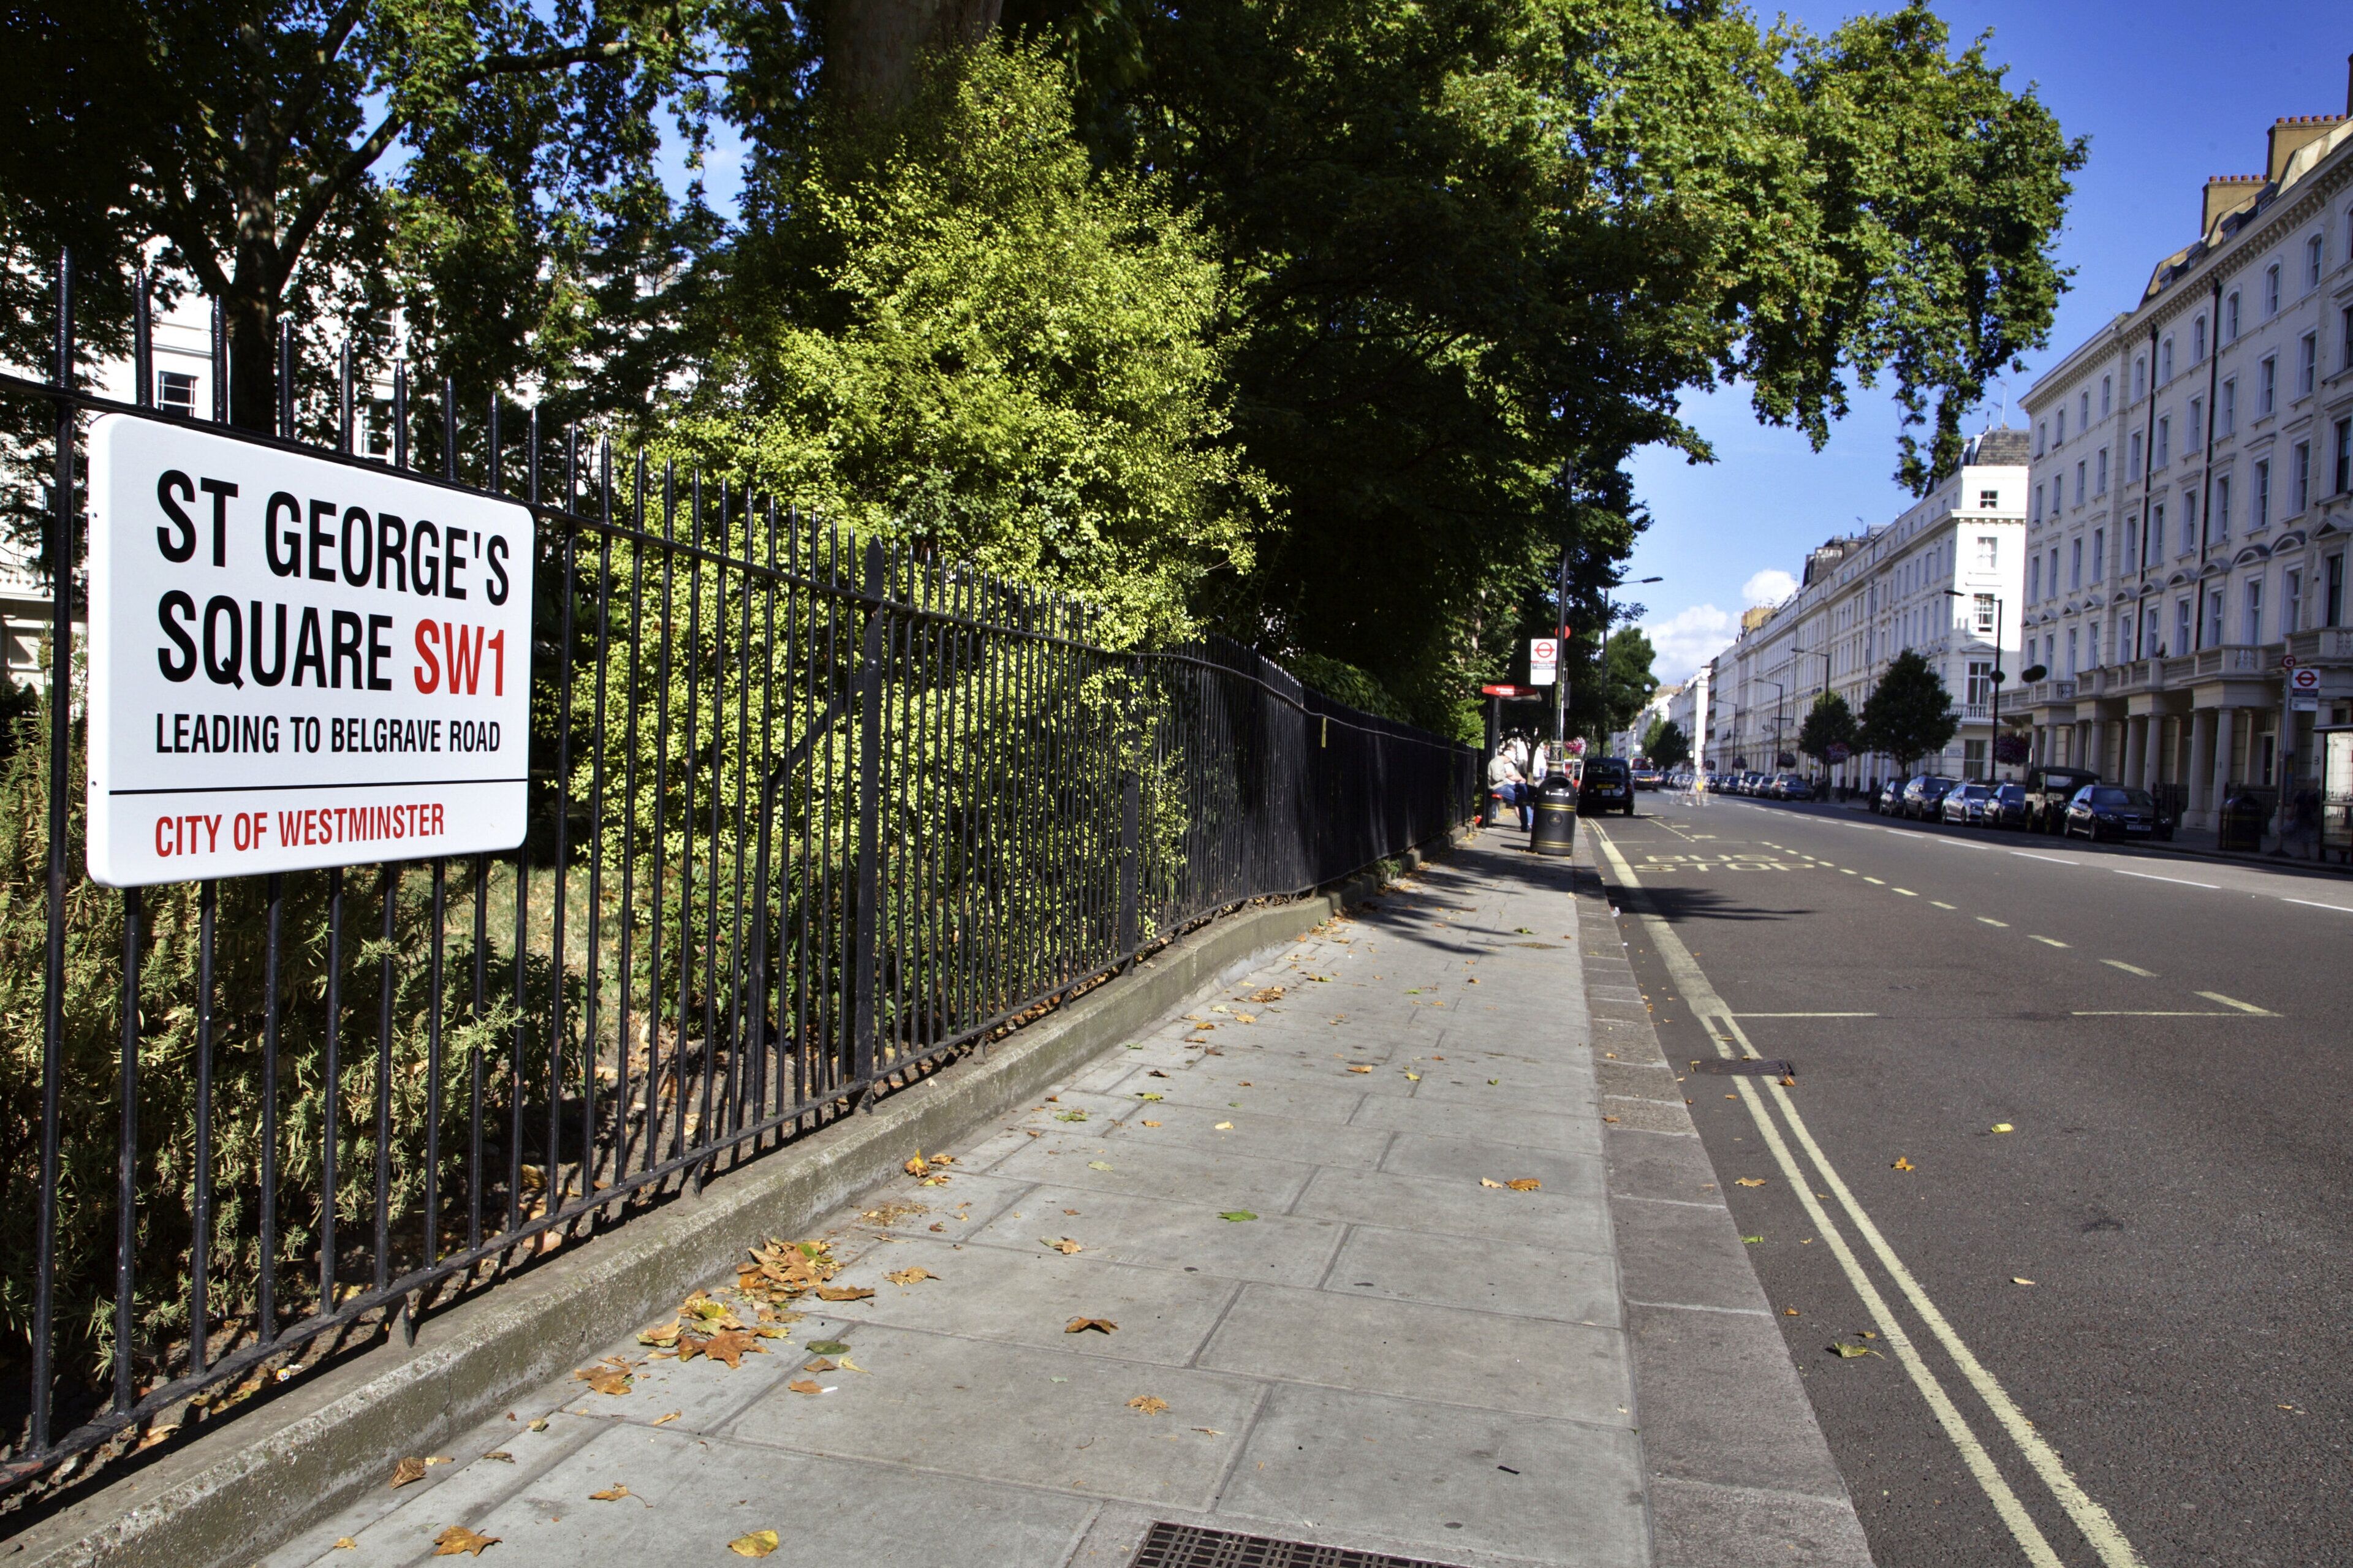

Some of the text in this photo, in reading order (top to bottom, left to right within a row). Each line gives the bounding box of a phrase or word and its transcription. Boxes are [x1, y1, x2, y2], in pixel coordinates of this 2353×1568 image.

[157, 470, 509, 605] ST GEORGE'S
[158, 590, 504, 696] SQUARE SW1
[2284, 657, 2294, 667] G
[157, 713, 500, 753] LEADING TO BELGRAVE ROAD
[156, 804, 443, 857] CITY OF WESTMINSTER
[1634, 863, 1815, 872] STOP
